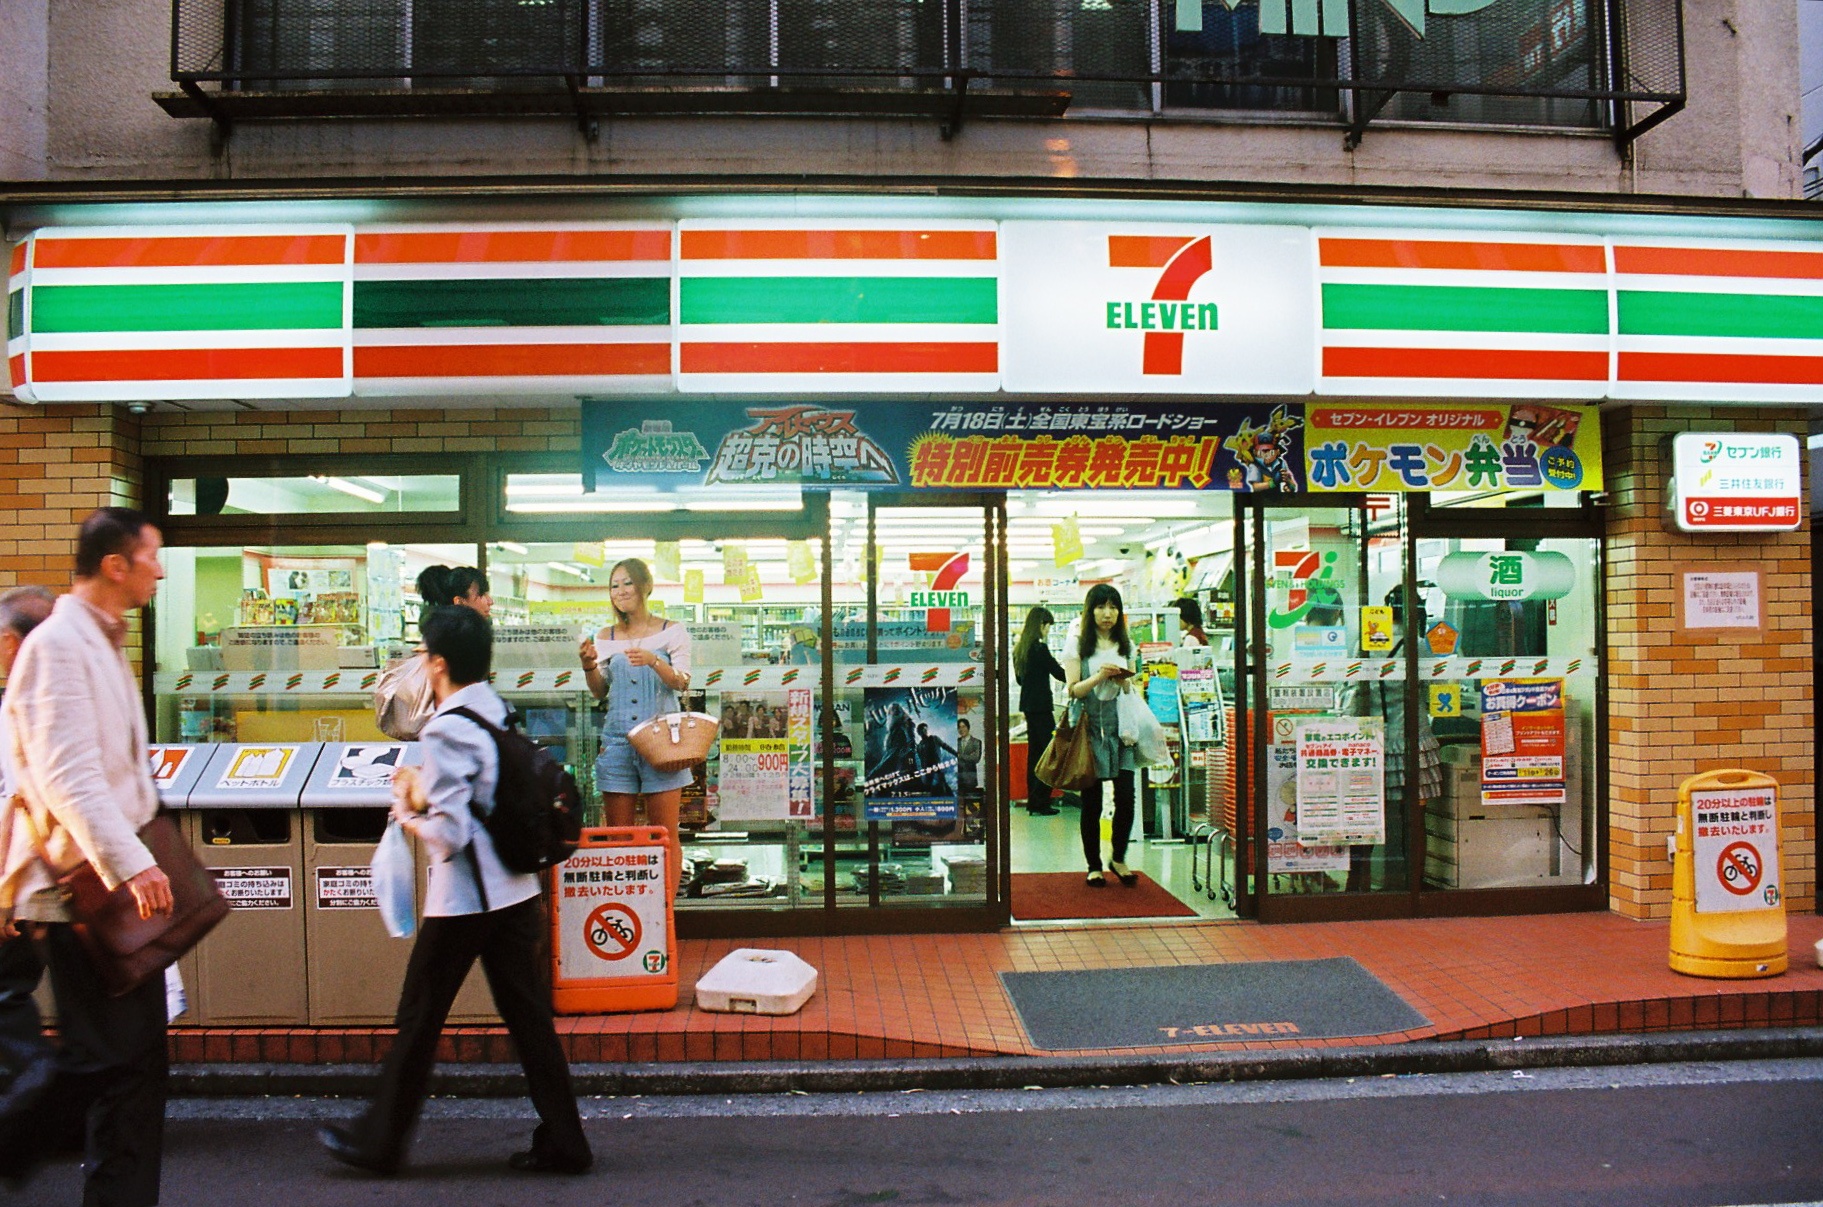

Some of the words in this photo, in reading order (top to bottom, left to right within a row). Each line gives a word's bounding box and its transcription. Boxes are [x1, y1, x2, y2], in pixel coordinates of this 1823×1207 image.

[1425, 413, 1485, 426] オリジナル
[716, 434, 891, 482] 超克の時空へ
[913, 437, 1219, 488] 特別前売券発売中!
[1310, 443, 1542, 487] ポケモン弁当
[1719, 479, 1784, 490] 三井住友銀行
[1713, 505, 1795, 518] 三菱東京UFJ銀行
[1490, 555, 1523, 585] 酒
[1490, 587, 1524, 599] liquor
[790, 690, 809, 814] 新規スタッフ大募集!
[758, 754, 789, 772] 900円
[1697, 796, 1771, 810] 20分以上の駐輪は
[1697, 810, 1772, 823] 無断駐輪と判断し
[1698, 824, 1769, 837] 撤去いたします。
[564, 855, 659, 869] 20分以上の駐輪は
[564, 869, 659, 883] 無断駐輪と判断し
[217, 880, 285, 889] 庭ゴミの持ち込みは
[564, 885, 654, 898] 撤去いたします。
